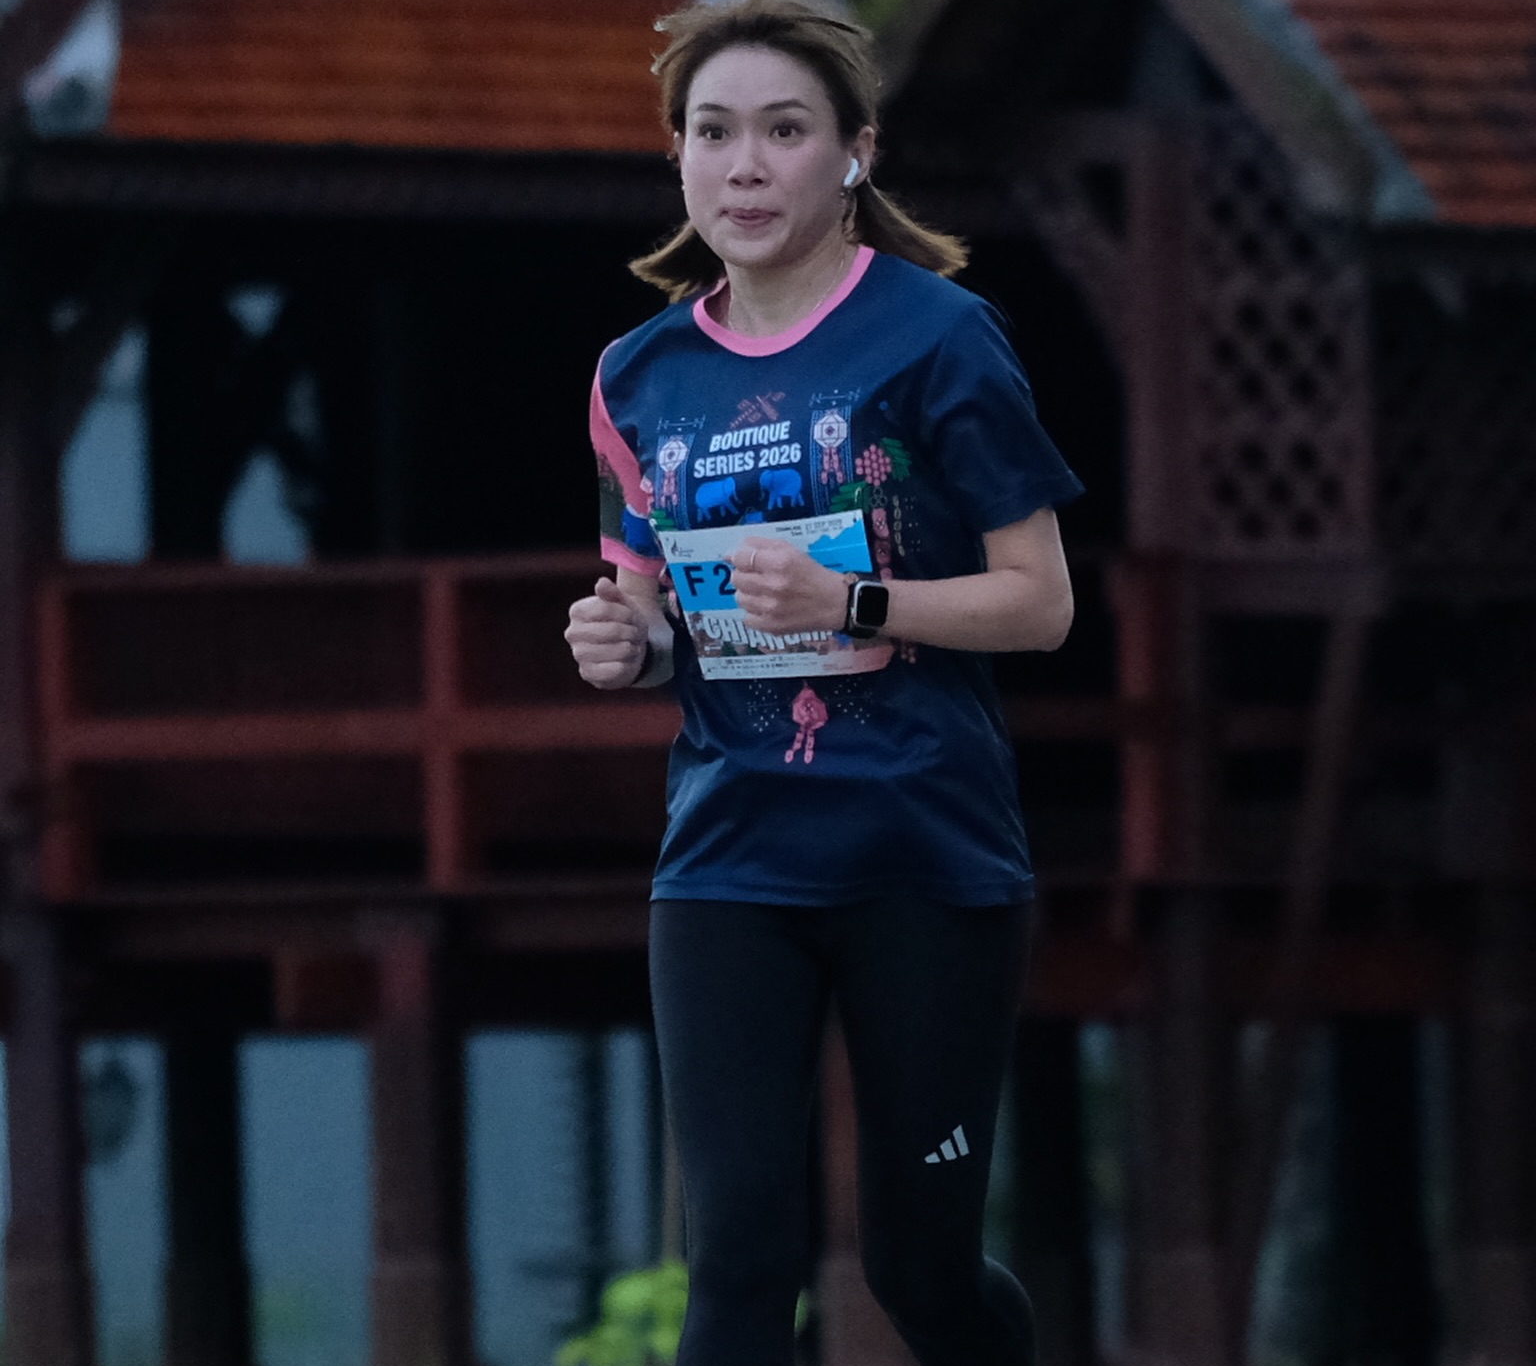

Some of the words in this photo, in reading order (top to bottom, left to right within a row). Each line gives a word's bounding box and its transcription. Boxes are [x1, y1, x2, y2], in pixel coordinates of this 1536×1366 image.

[709, 420, 791, 453] BOUTIQUE
[693, 450, 755, 479] SERIES
[758, 442, 802, 468] 2026
[682, 562, 736, 597] F2
